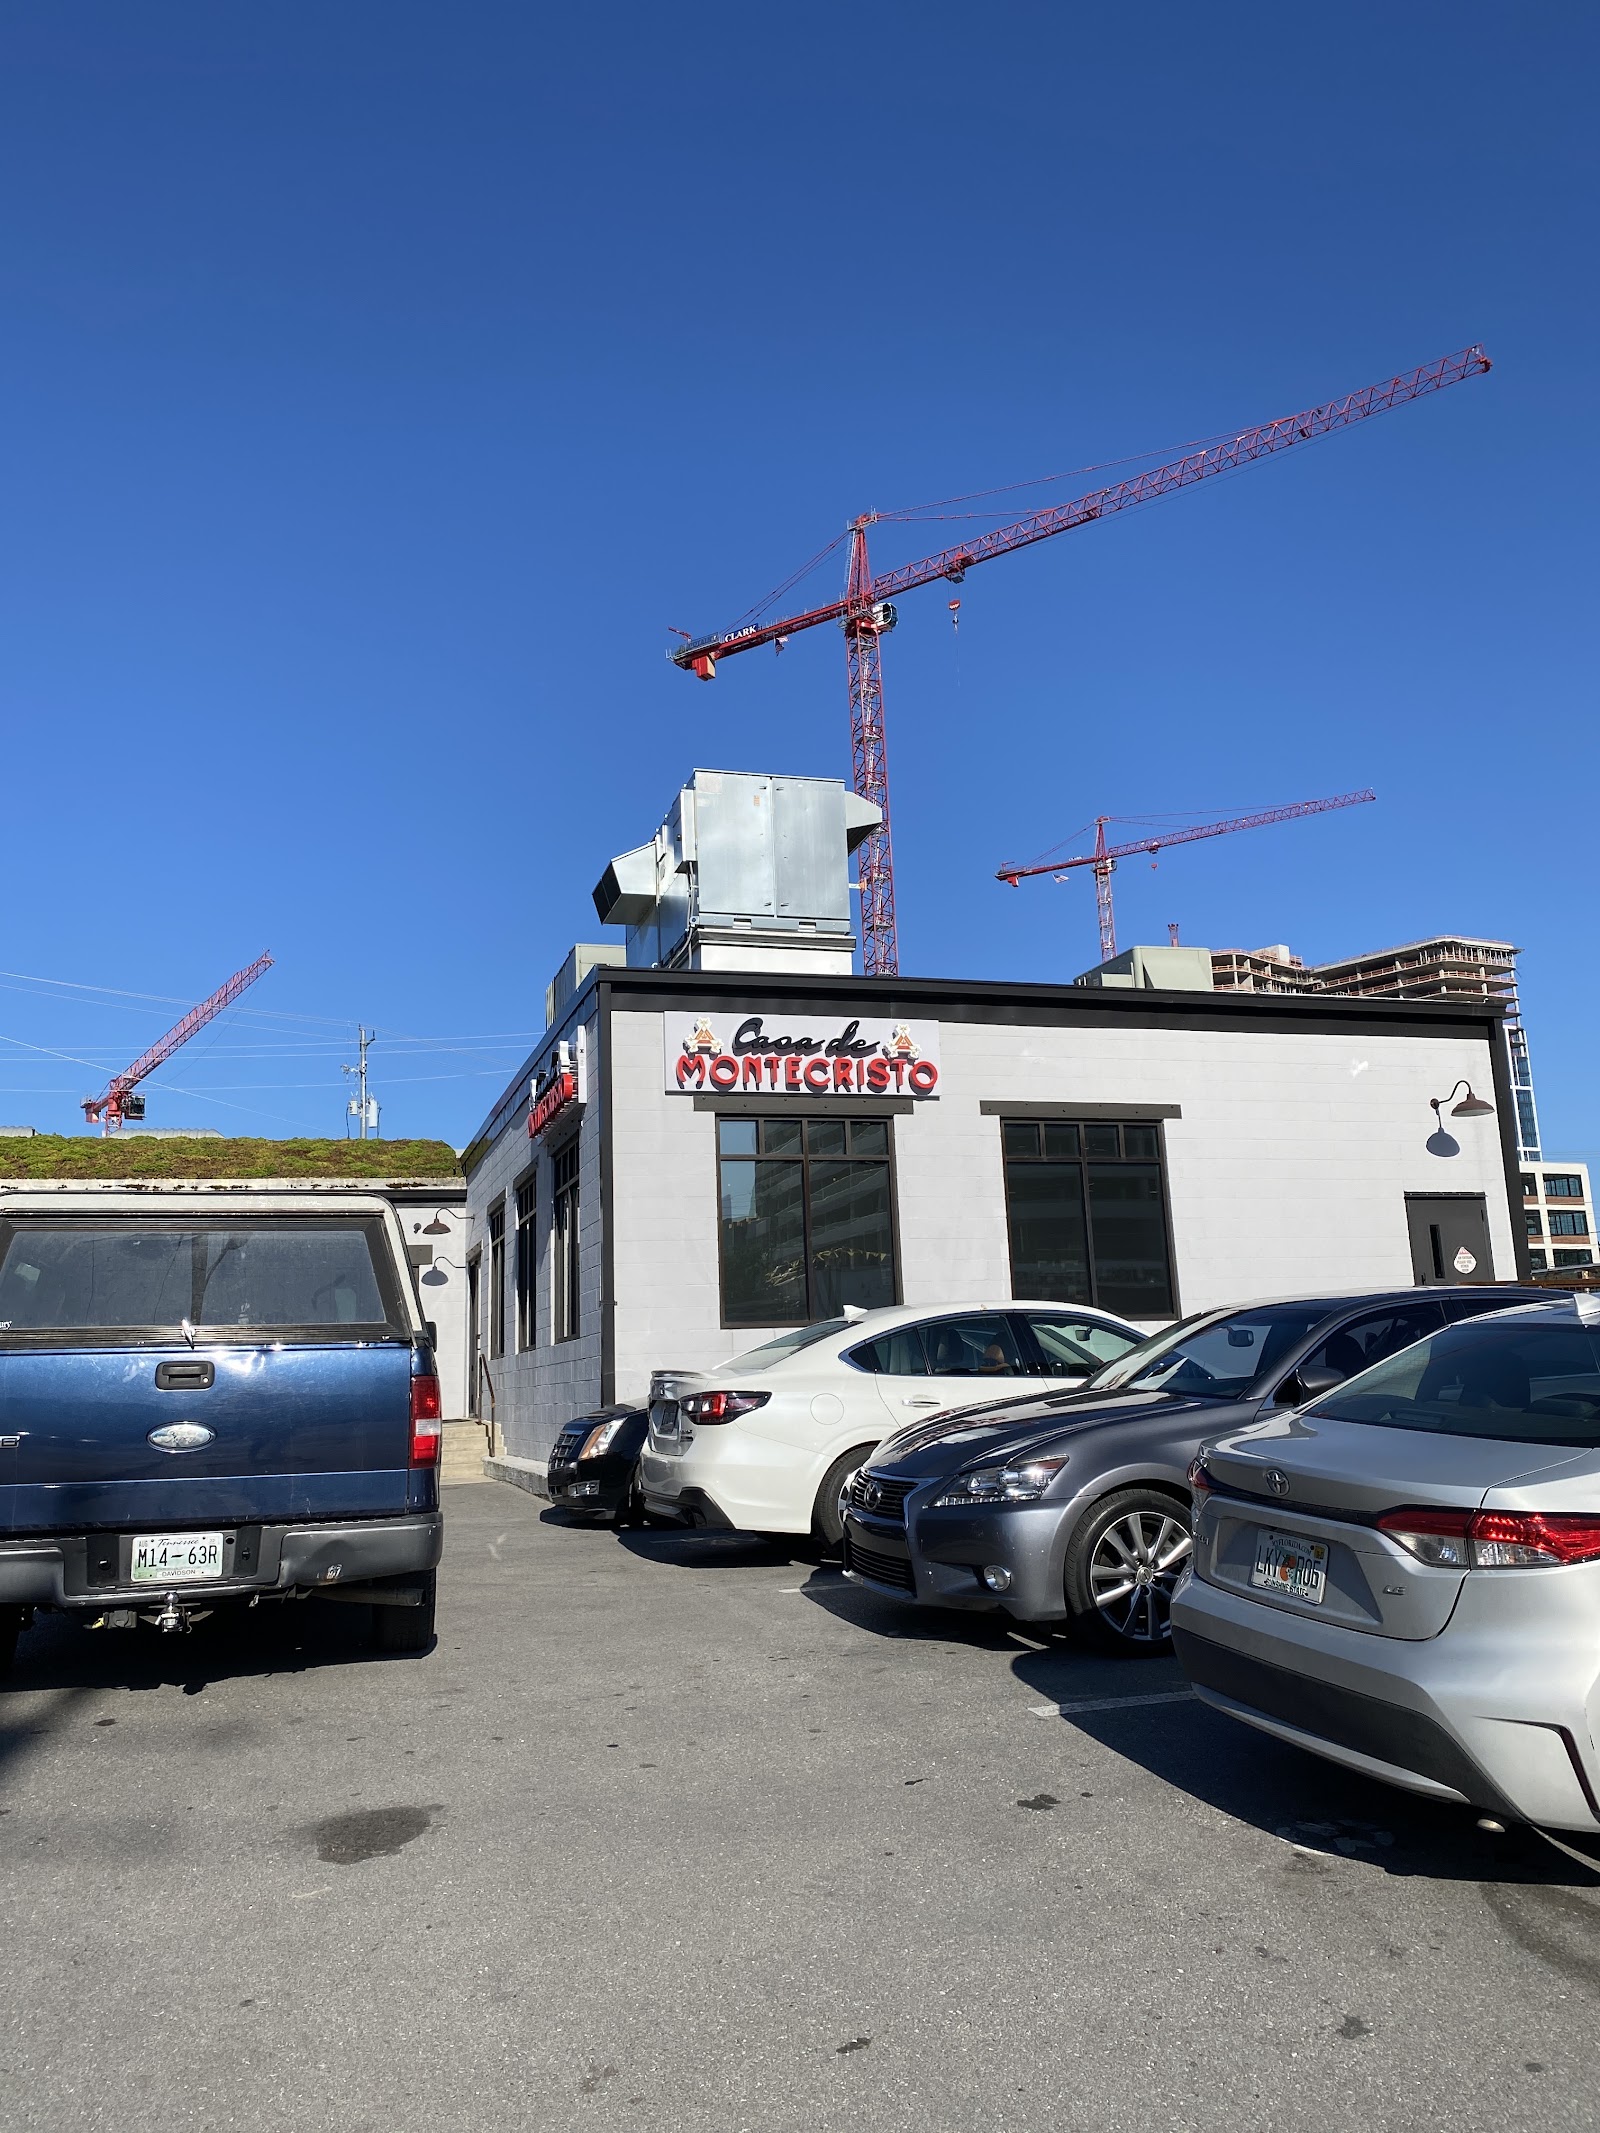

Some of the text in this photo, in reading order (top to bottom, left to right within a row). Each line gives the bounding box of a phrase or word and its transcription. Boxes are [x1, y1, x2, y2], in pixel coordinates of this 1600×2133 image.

[724, 625, 757, 642] CLARK
[733, 1017, 880, 1055] Casa de
[676, 1054, 938, 1090] MONTECRISTO
[158, 1538, 200, 1547] Tennessee
[162, 1569, 196, 1577] DAVIDSON
[1255, 1545, 1281, 1578] LKY
